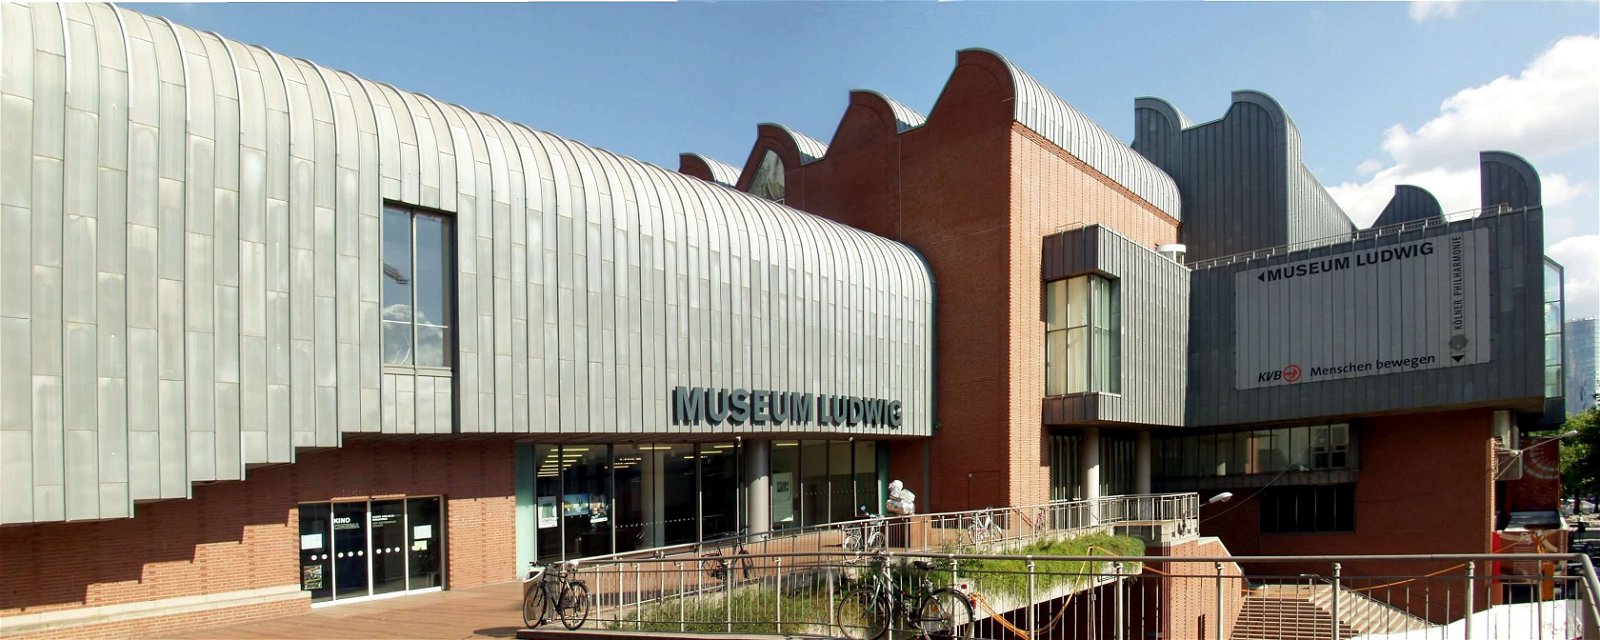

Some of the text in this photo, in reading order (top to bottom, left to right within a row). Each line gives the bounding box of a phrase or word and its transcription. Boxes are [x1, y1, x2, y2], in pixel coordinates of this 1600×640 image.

[1267, 241, 1434, 282] MUSEUM LUDWIG
[1452, 236, 1463, 330] KÖLNER PHILHARMONIE
[1258, 370, 1282, 382] KVB
[1310, 355, 1435, 377] Menschen bewegen
[673, 386, 903, 428] MUSEUM LUDWIG
